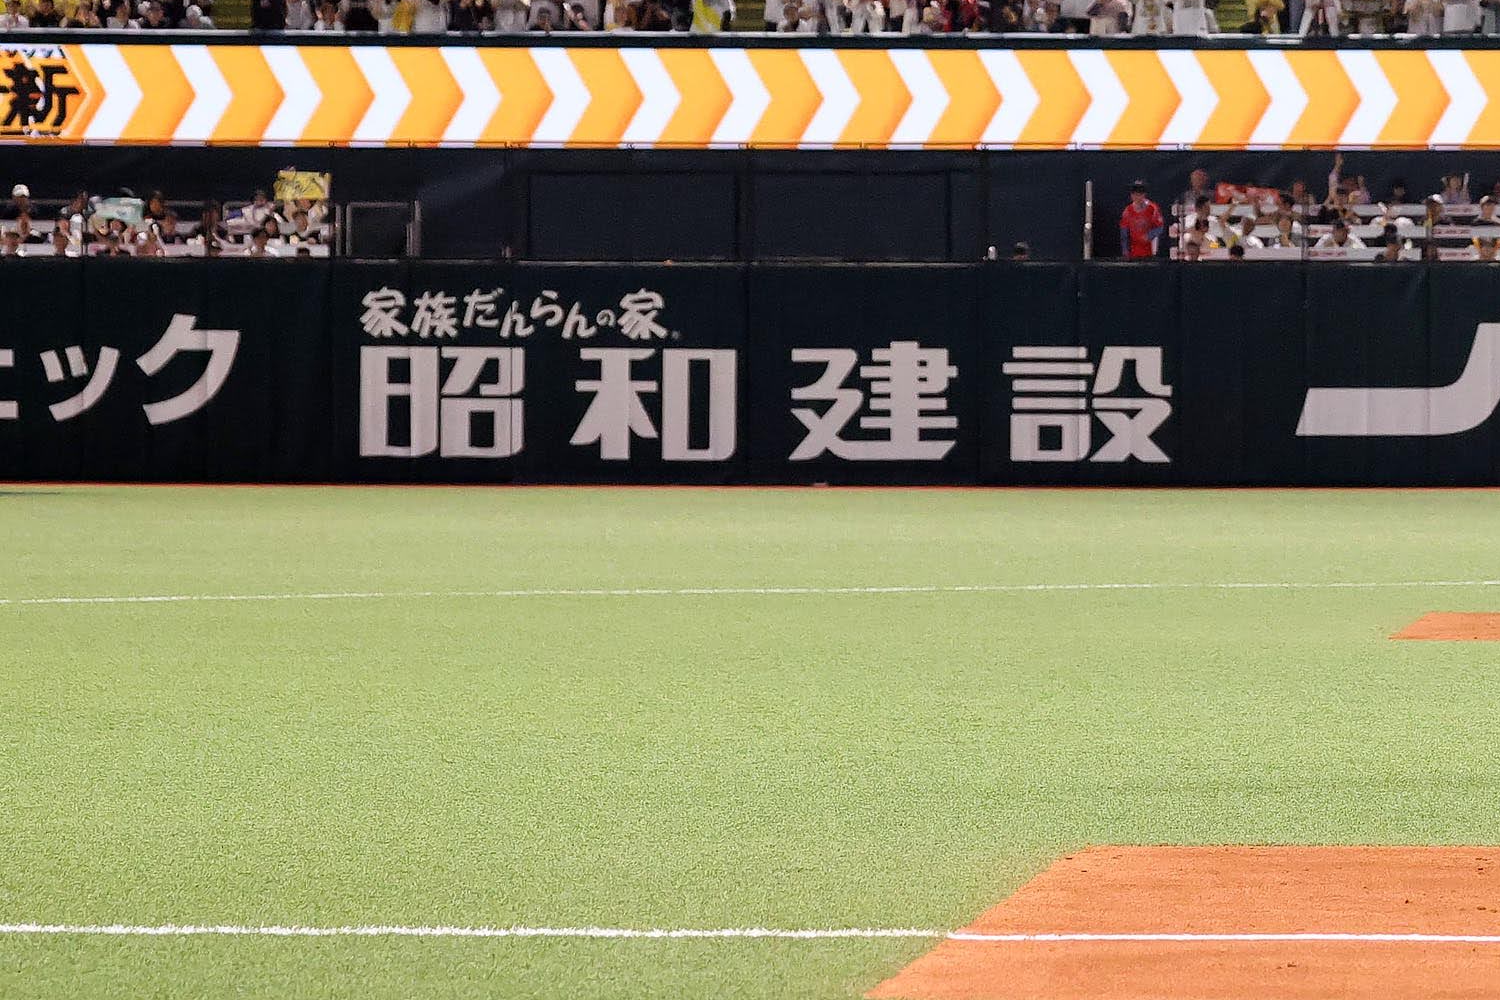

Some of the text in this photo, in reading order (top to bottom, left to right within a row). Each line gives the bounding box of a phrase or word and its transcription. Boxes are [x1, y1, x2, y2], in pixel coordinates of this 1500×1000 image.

[0, 63, 80, 126] 新
[0, 313, 241, 425] ック
[359, 340, 1173, 463] 昭和建設
